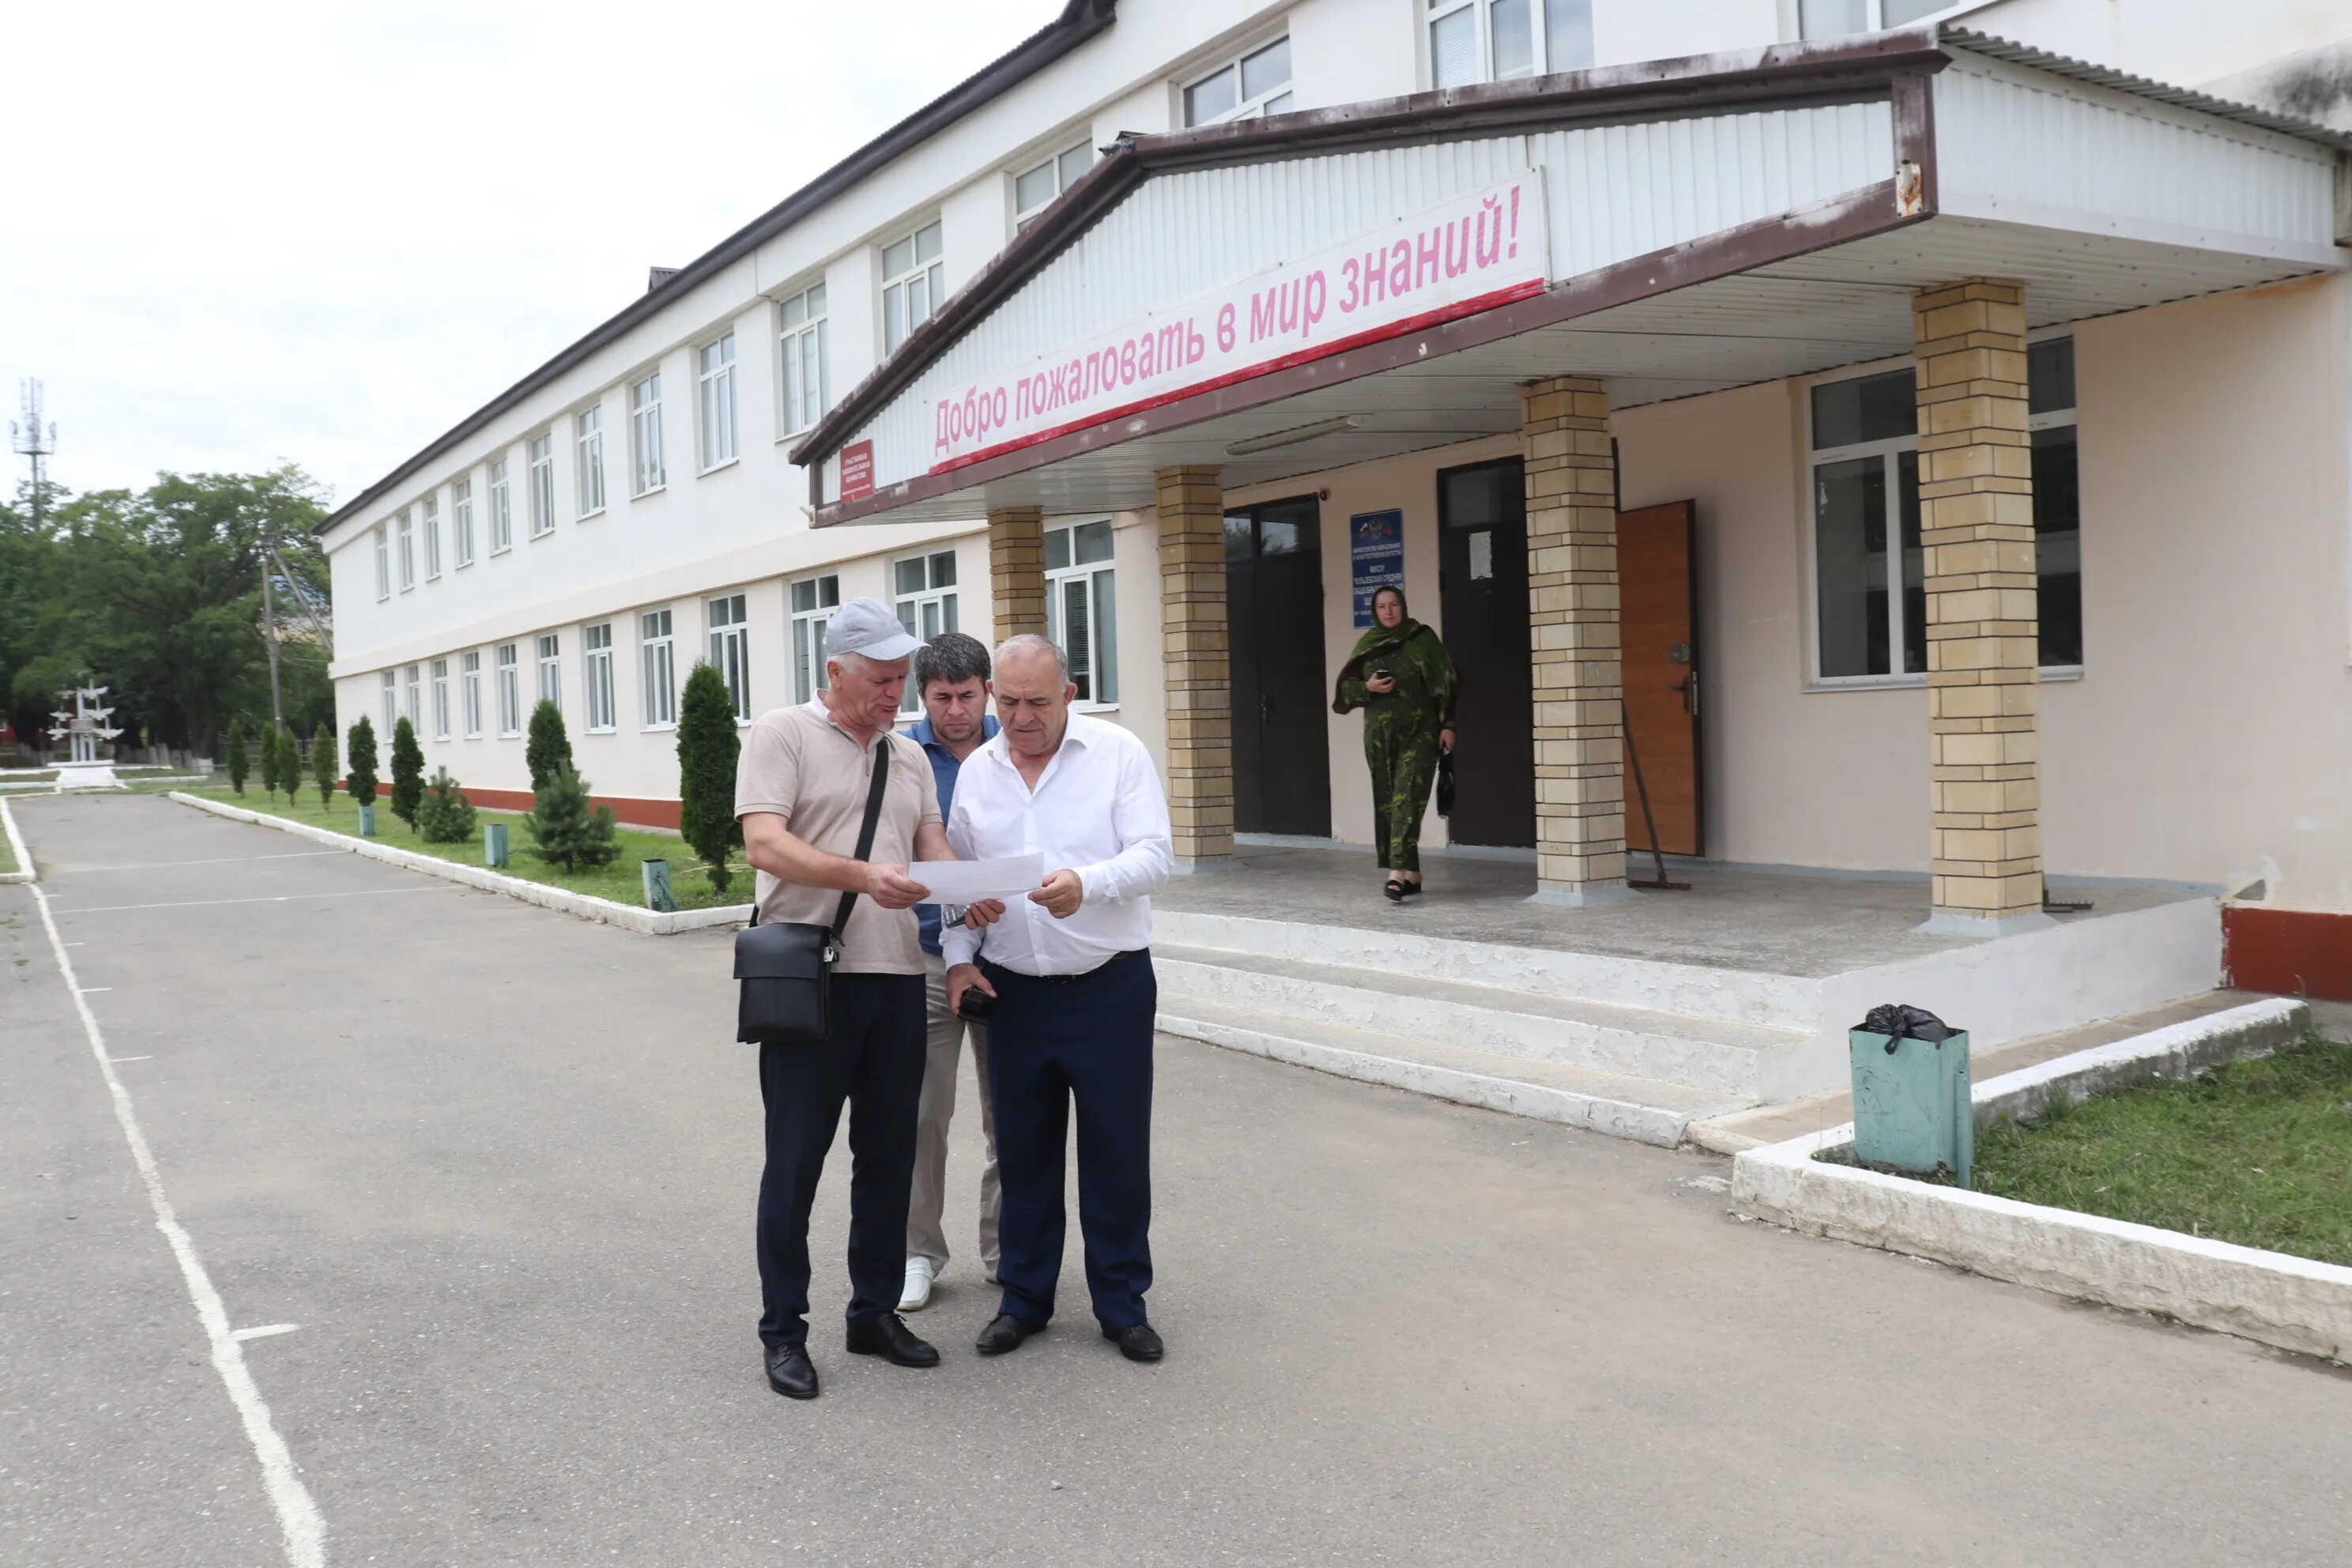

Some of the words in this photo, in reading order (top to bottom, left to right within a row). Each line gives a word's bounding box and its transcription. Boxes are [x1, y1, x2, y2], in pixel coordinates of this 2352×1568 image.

[934, 386, 1008, 457] Добро
[1016, 318, 1204, 420] пожаловать
[1217, 303, 1236, 351] в
[1250, 270, 1327, 342] мир
[1340, 186, 1521, 312] знаний!
